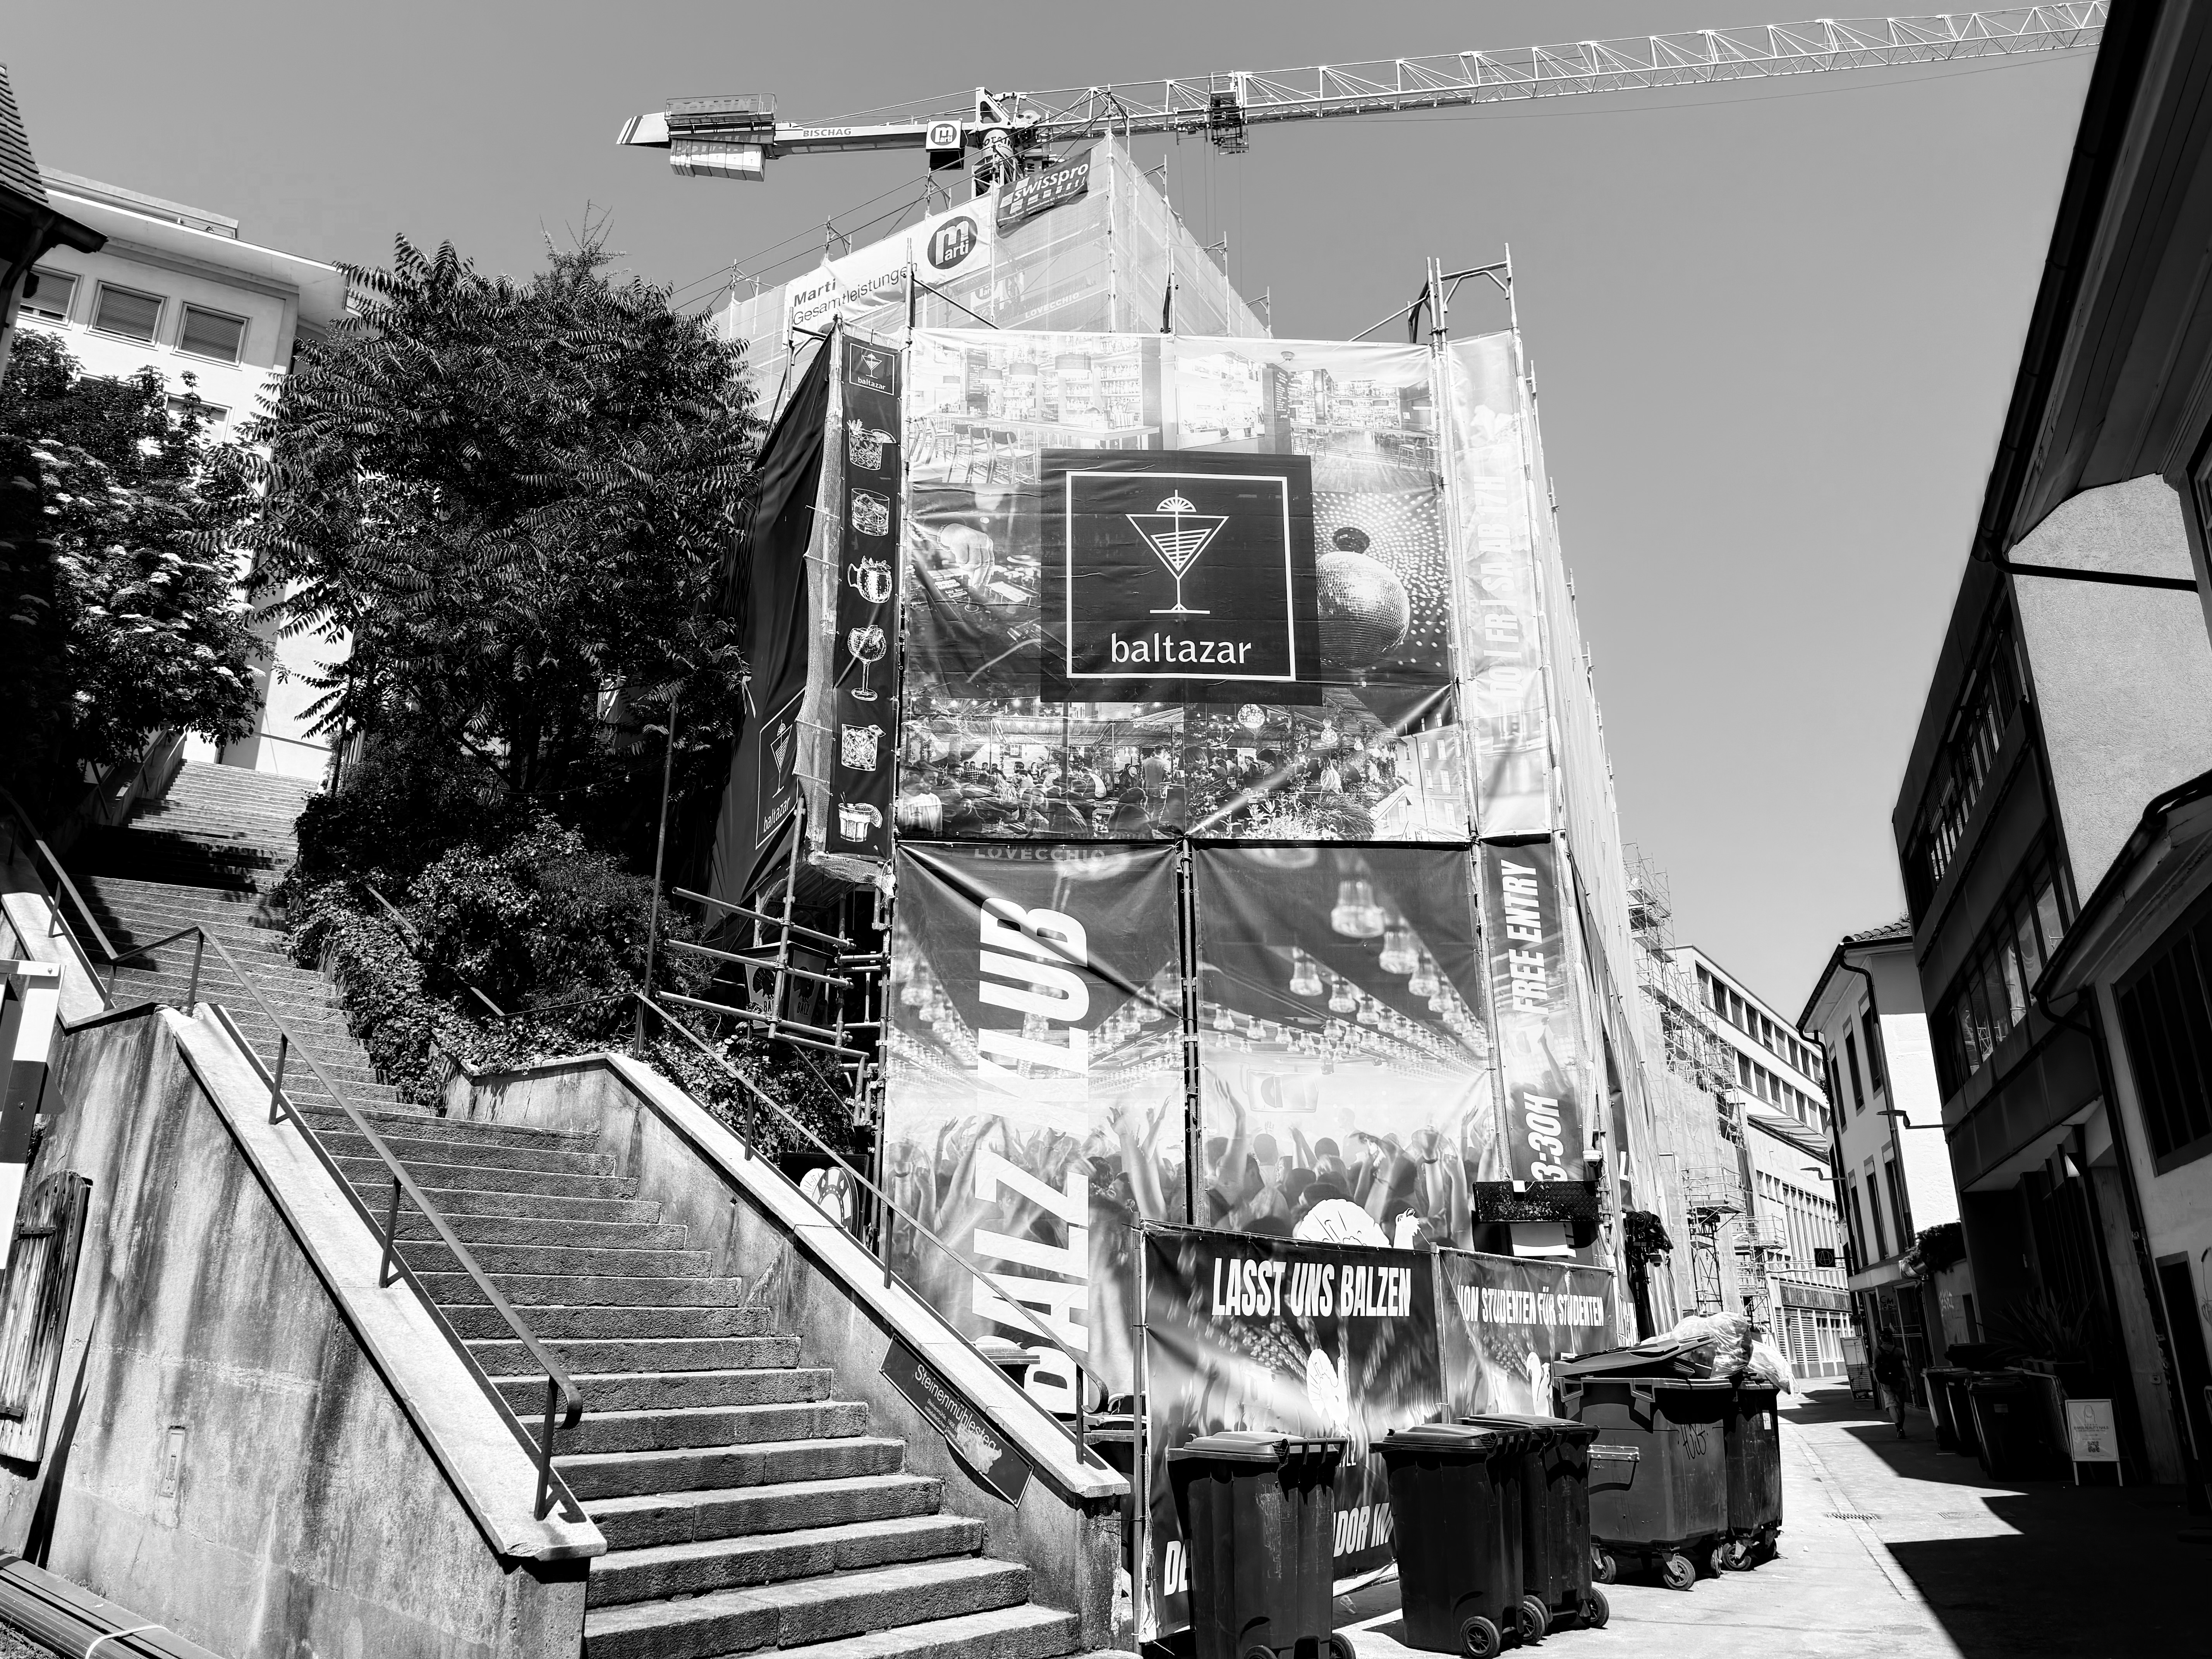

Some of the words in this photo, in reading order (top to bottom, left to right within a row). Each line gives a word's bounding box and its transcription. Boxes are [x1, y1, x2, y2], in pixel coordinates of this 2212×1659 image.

[803, 129, 851, 137] BISCHAG
[1014, 164, 1089, 201] swisspro
[936, 221, 969, 265] marti
[793, 262, 917, 325] Gesamtleistungen
[794, 278, 836, 307] Marti
[1025, 292, 1080, 319] LOVECCHIO
[858, 376, 886, 390] baltazar
[1473, 476, 1508, 515] 17H
[1477, 524, 1511, 554] AB
[1480, 562, 1515, 592] SA
[1485, 613, 1519, 643] FR
[1112, 632, 1251, 663] baltazar
[1490, 666, 1523, 698] DO
[763, 796, 791, 833] baltazar
[974, 848, 1106, 862] LOVECCHIO
[1501, 860, 1542, 945] ENTRY
[1508, 948, 1549, 1015] FREE
[977, 897, 1089, 1137] KLUB
[1211, 1257, 1286, 1316] LASST
[1291, 1262, 1335, 1317] UNS
[1340, 1266, 1412, 1317] BALZEN
[1457, 1285, 1479, 1322] VON
[1482, 1287, 1537, 1325] STUDENTEN
[1537, 1286, 1556, 1326] FÜR
[1557, 1294, 1604, 1327] STUDENTEN
